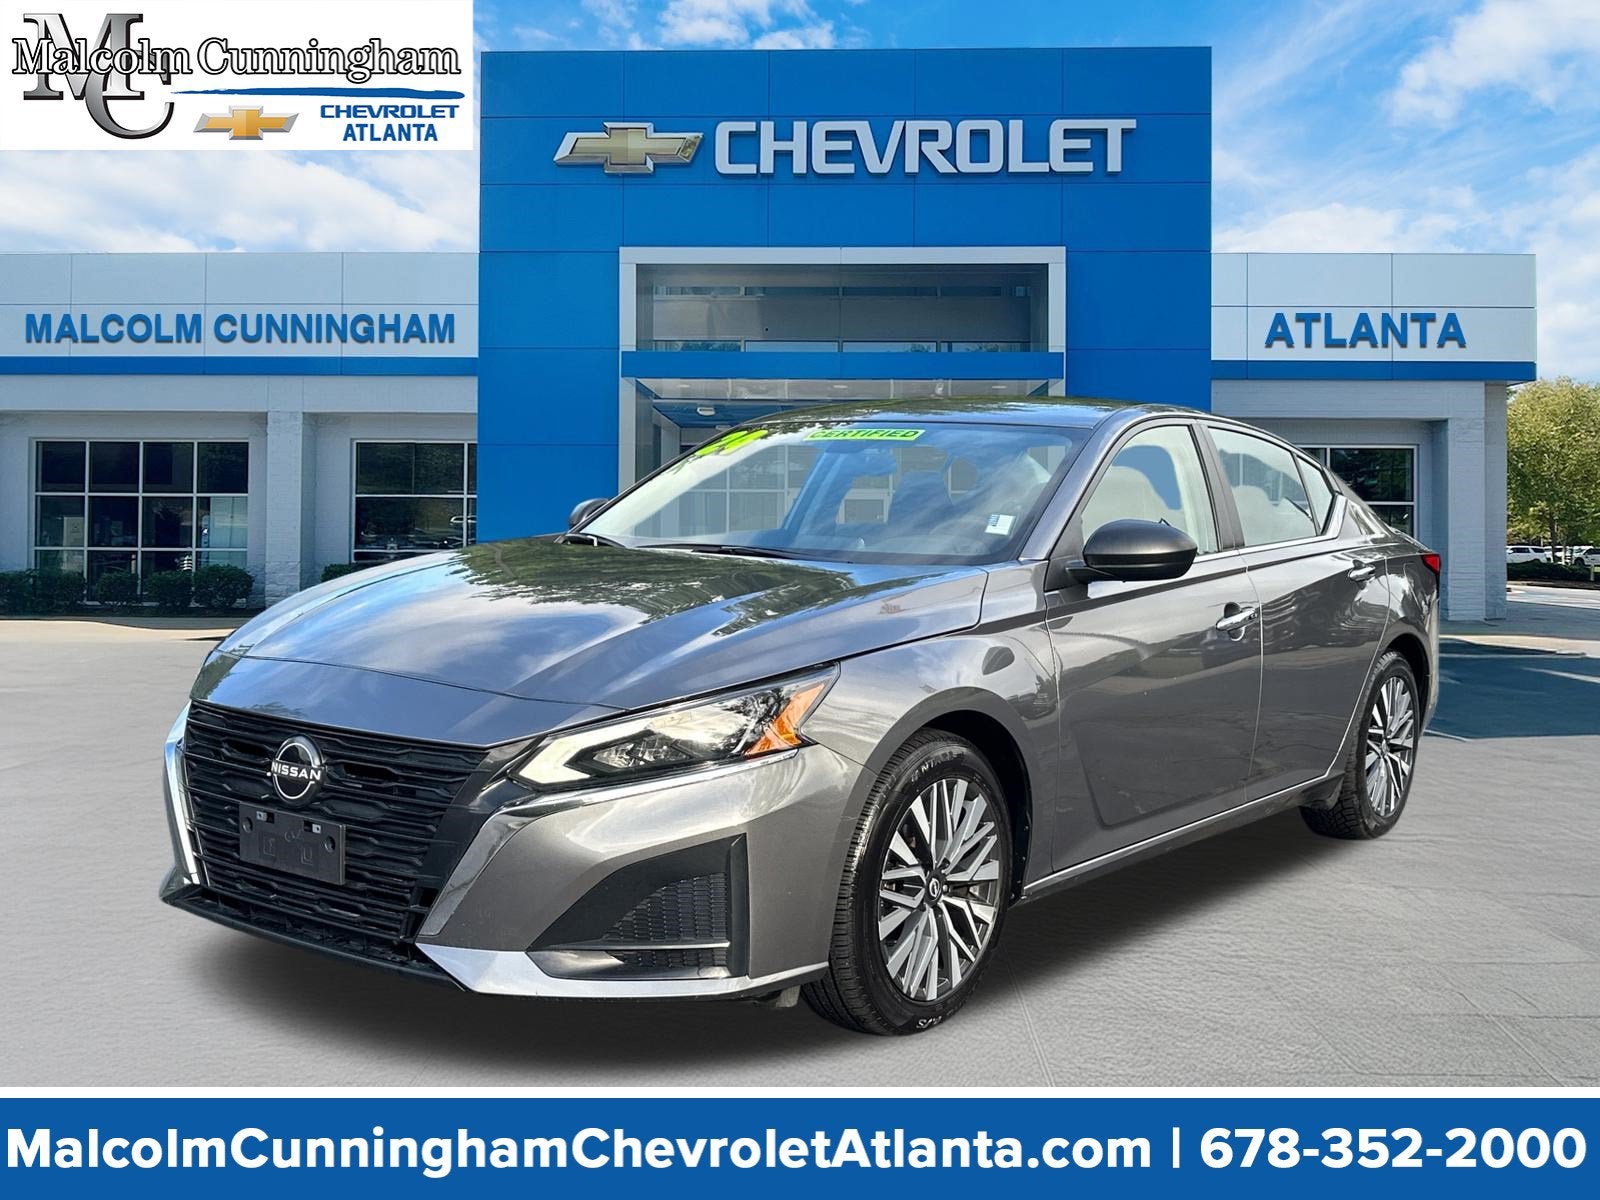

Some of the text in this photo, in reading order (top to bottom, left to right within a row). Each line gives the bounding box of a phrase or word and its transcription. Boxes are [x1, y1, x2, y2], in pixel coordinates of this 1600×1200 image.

[715, 119, 1137, 175] CHEVROLET
[25, 312, 456, 343] MALCOLM CUNNINGHAM
[1264, 311, 1467, 348] ATLANTA
[809, 428, 920, 439] CERTIFIED
[271, 761, 322, 781] NISSAN
